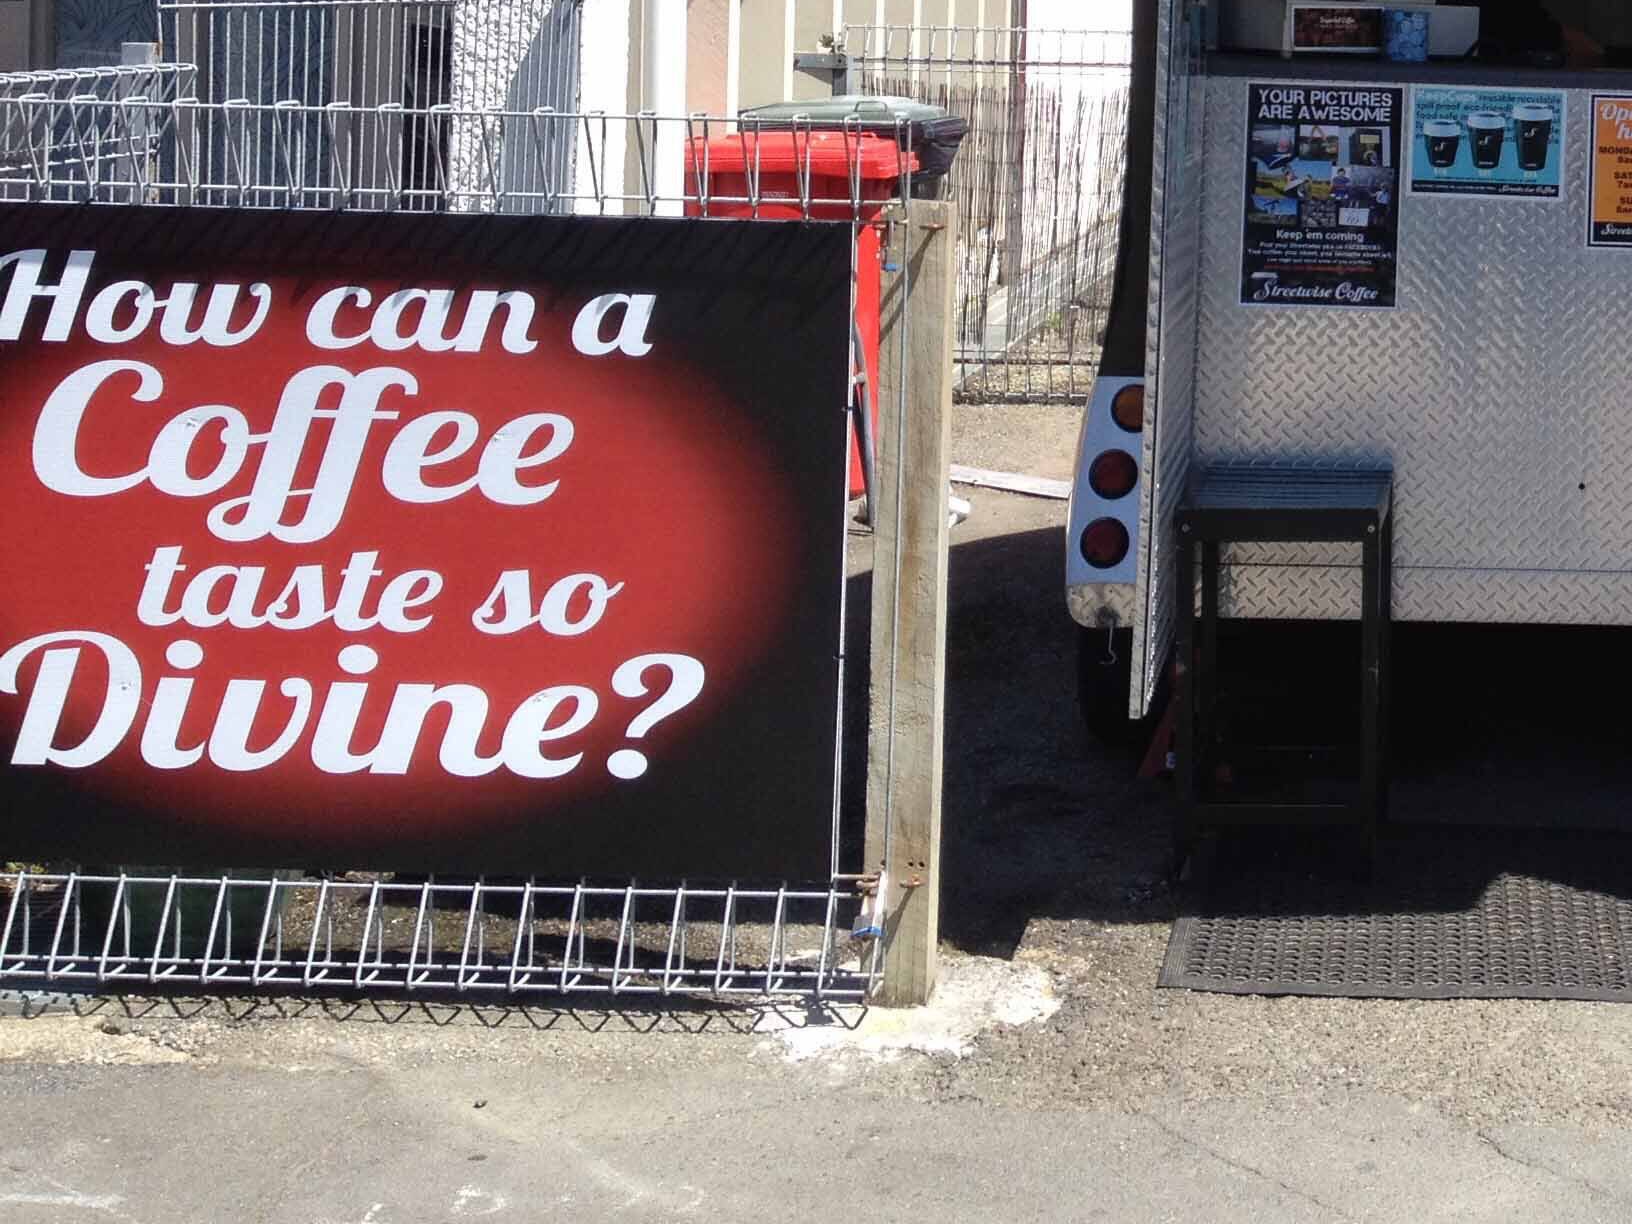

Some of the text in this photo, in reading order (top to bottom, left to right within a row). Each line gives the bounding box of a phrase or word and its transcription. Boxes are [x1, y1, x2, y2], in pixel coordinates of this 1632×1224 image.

[1258, 89, 1392, 107] YOUR PICTURES
[1258, 104, 1391, 122] ARE AWESOME
[1276, 229, 1303, 241] Keep
[1325, 232, 1364, 243] coming
[0, 248, 657, 357] How can a
[1253, 278, 1378, 303] Streetwise Coffee
[31, 359, 576, 544] Coffee
[136, 545, 624, 636] taste so
[0, 629, 706, 780] Divine?
